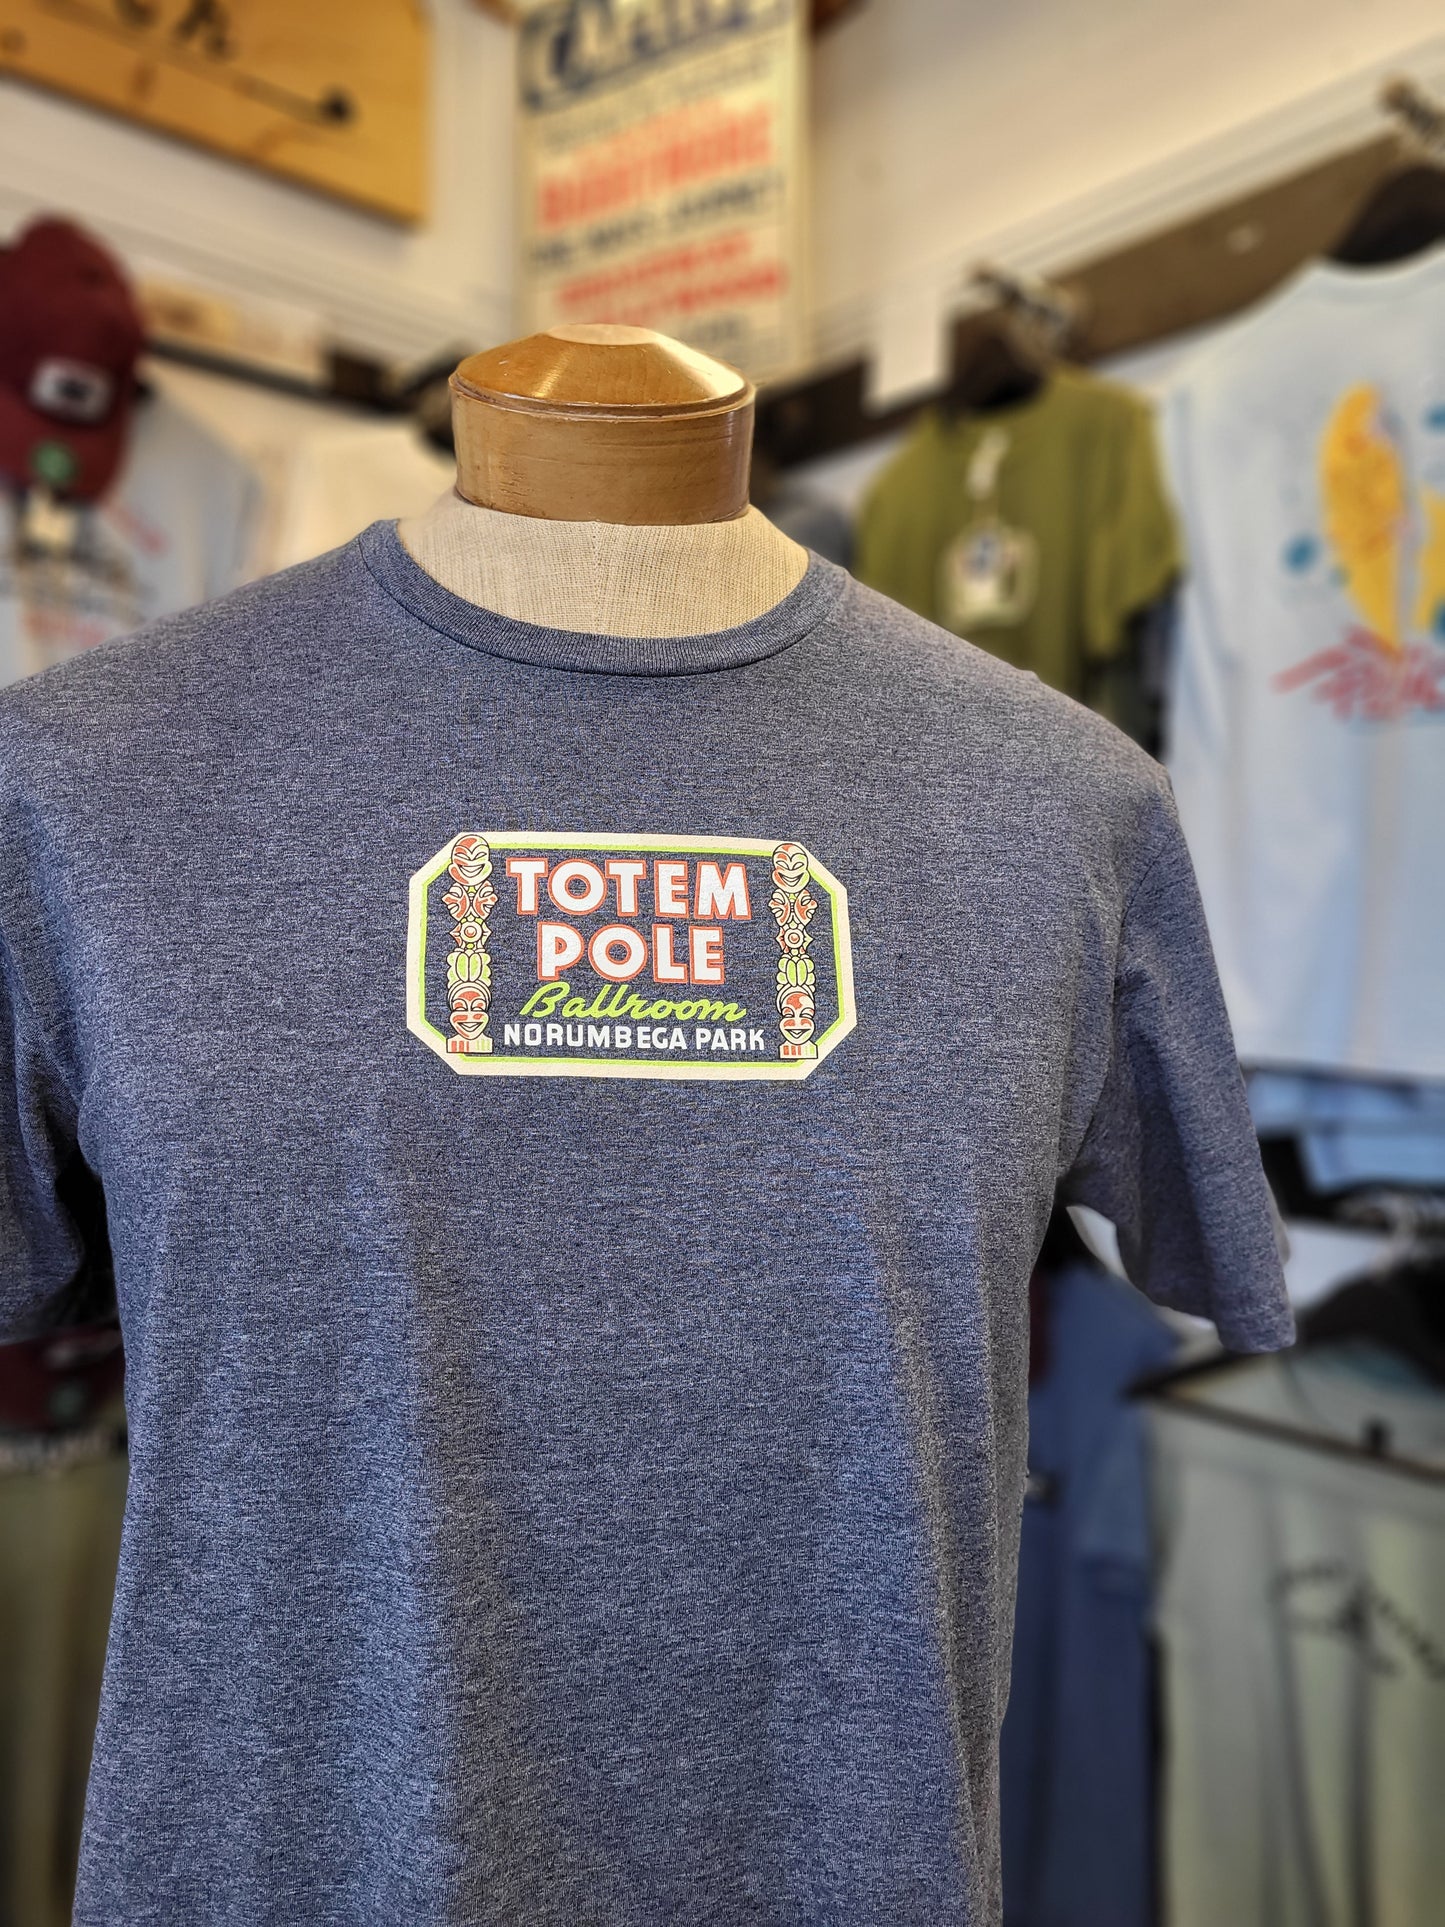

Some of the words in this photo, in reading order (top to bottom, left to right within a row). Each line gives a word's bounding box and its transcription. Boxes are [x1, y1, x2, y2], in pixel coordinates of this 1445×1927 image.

[507, 857, 752, 920] TOTEM
[537, 920, 725, 984] POLE
[520, 981, 746, 1021] Ballroom
[504, 1023, 687, 1049] NORUMBEGA
[696, 1027, 765, 1051] PARK
